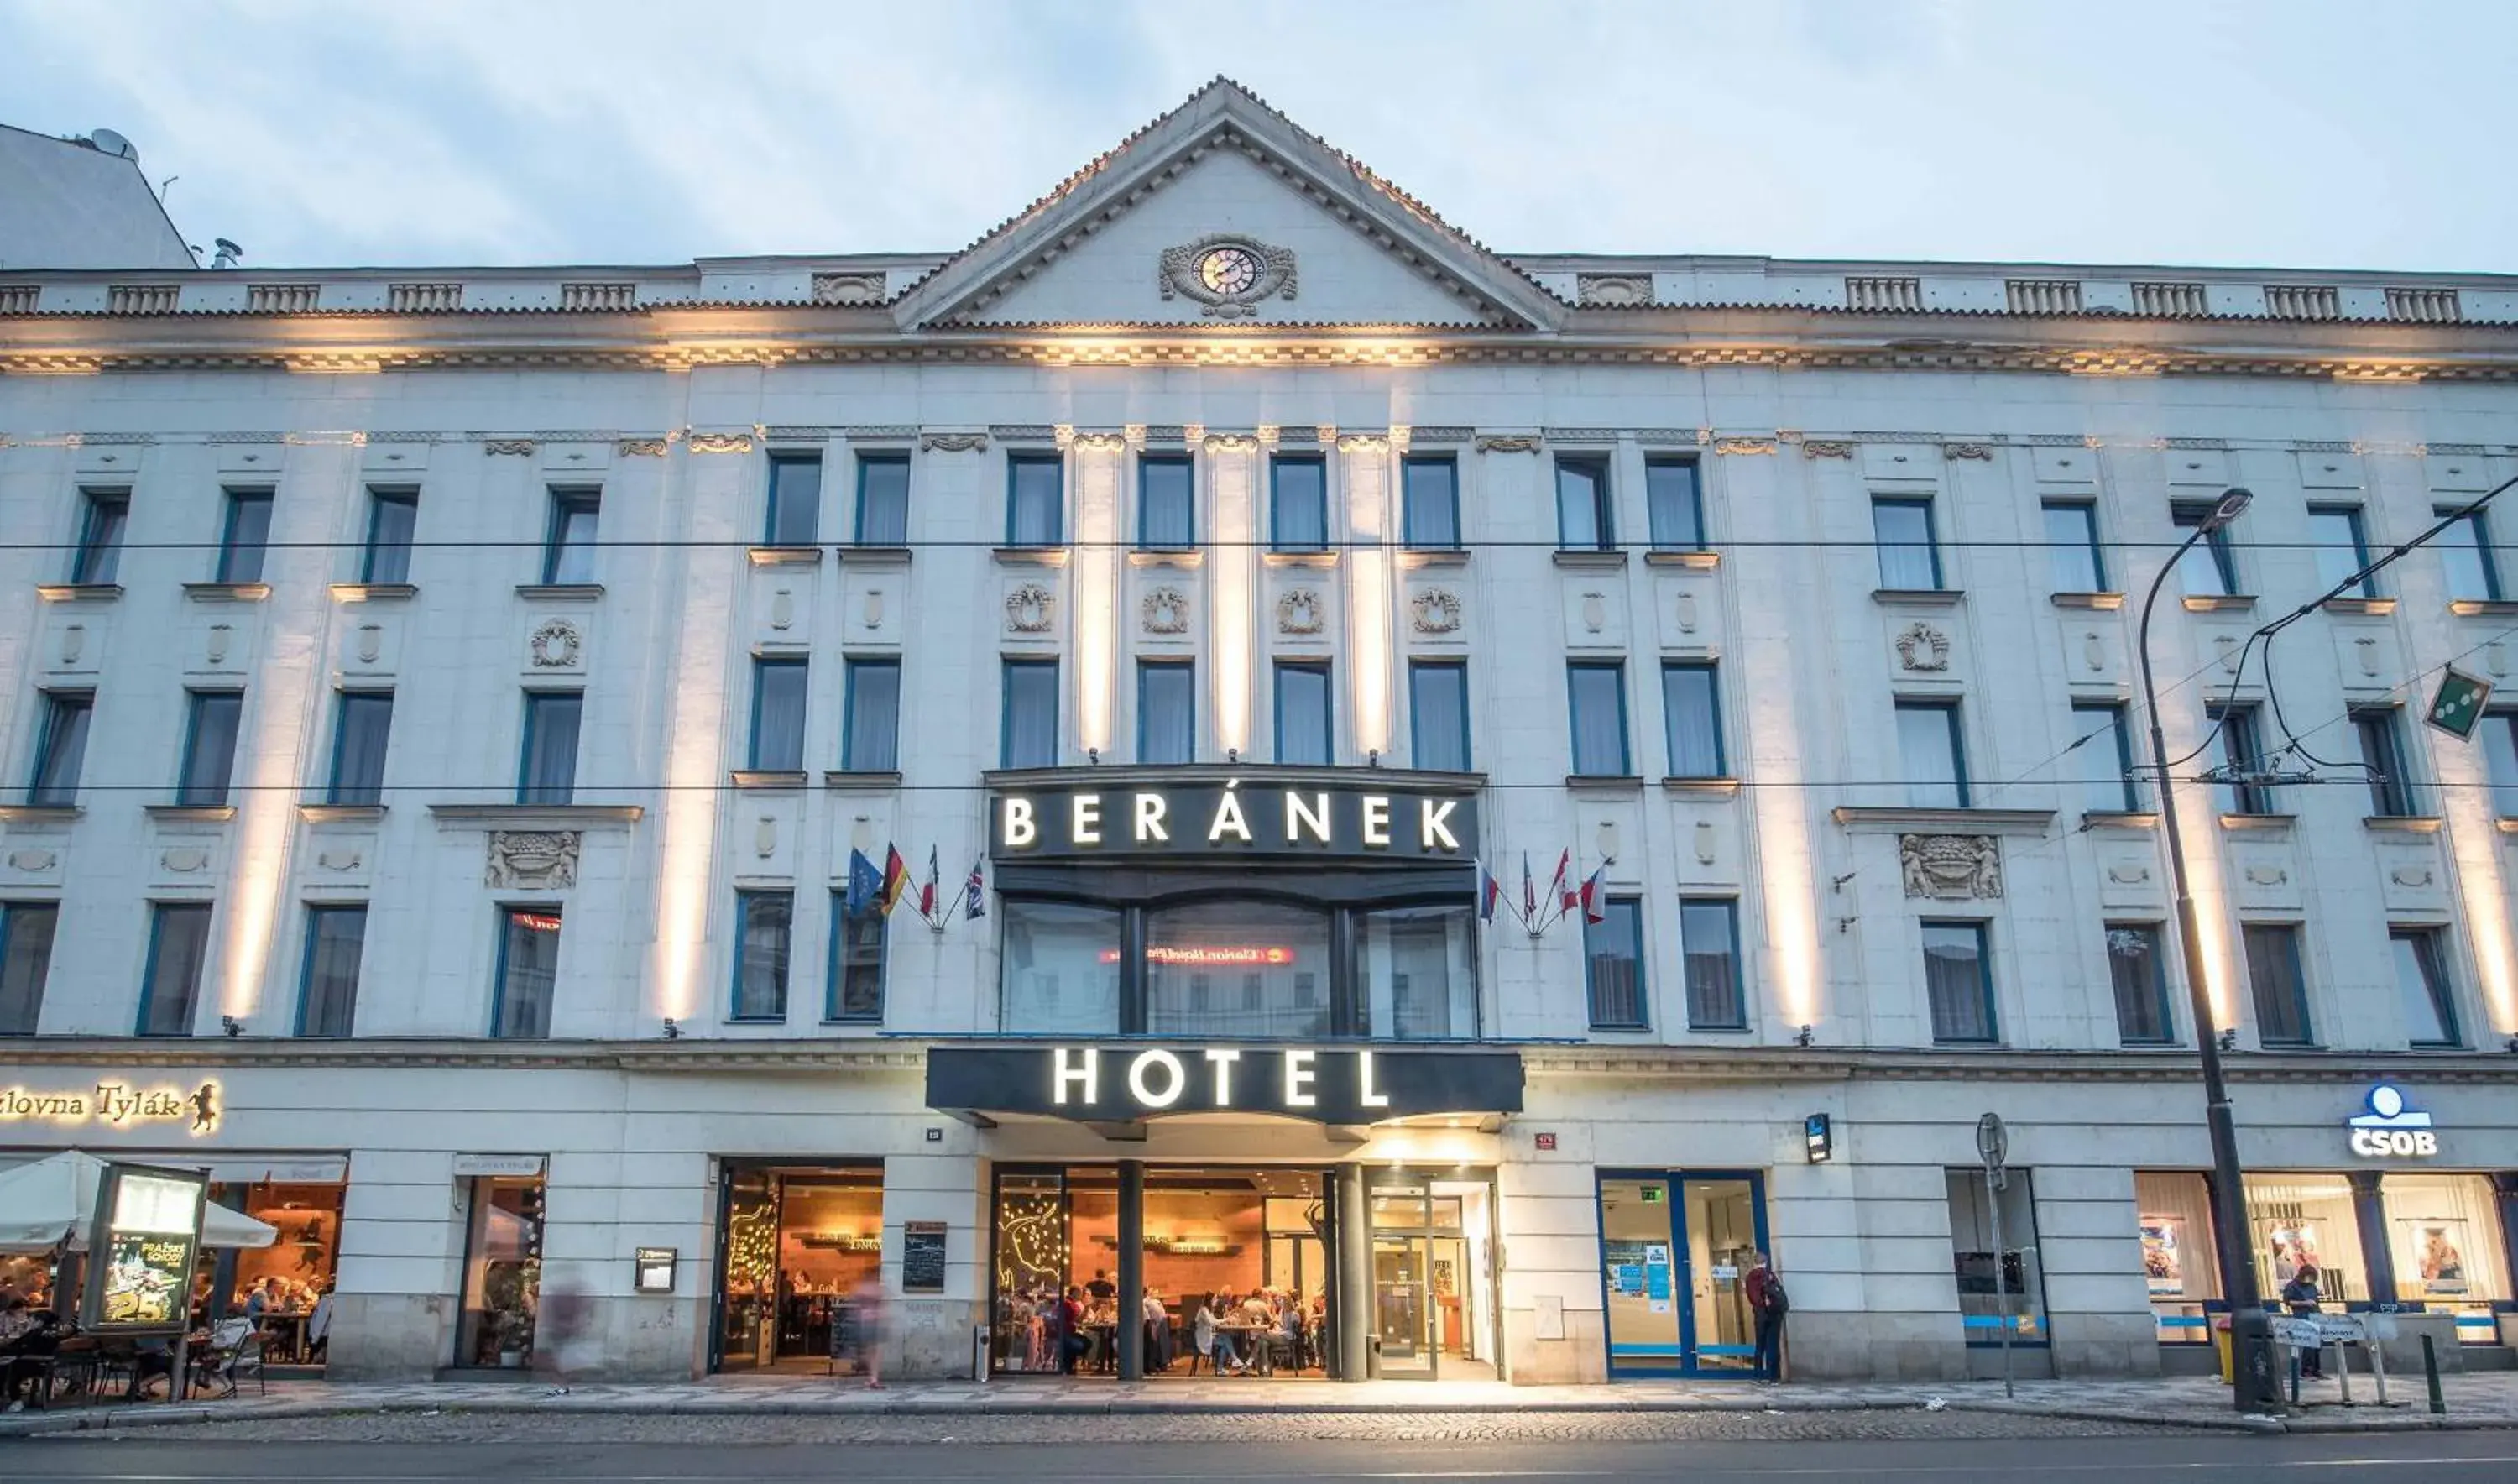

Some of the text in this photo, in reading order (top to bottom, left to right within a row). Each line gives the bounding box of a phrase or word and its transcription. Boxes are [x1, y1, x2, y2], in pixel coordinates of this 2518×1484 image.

[1005, 778, 1460, 849] BERÁNEK
[1054, 1048, 1389, 1107] HOTEL
[97, 1084, 180, 1121] Tylák
[2352, 1128, 2437, 1156] ČSOB
